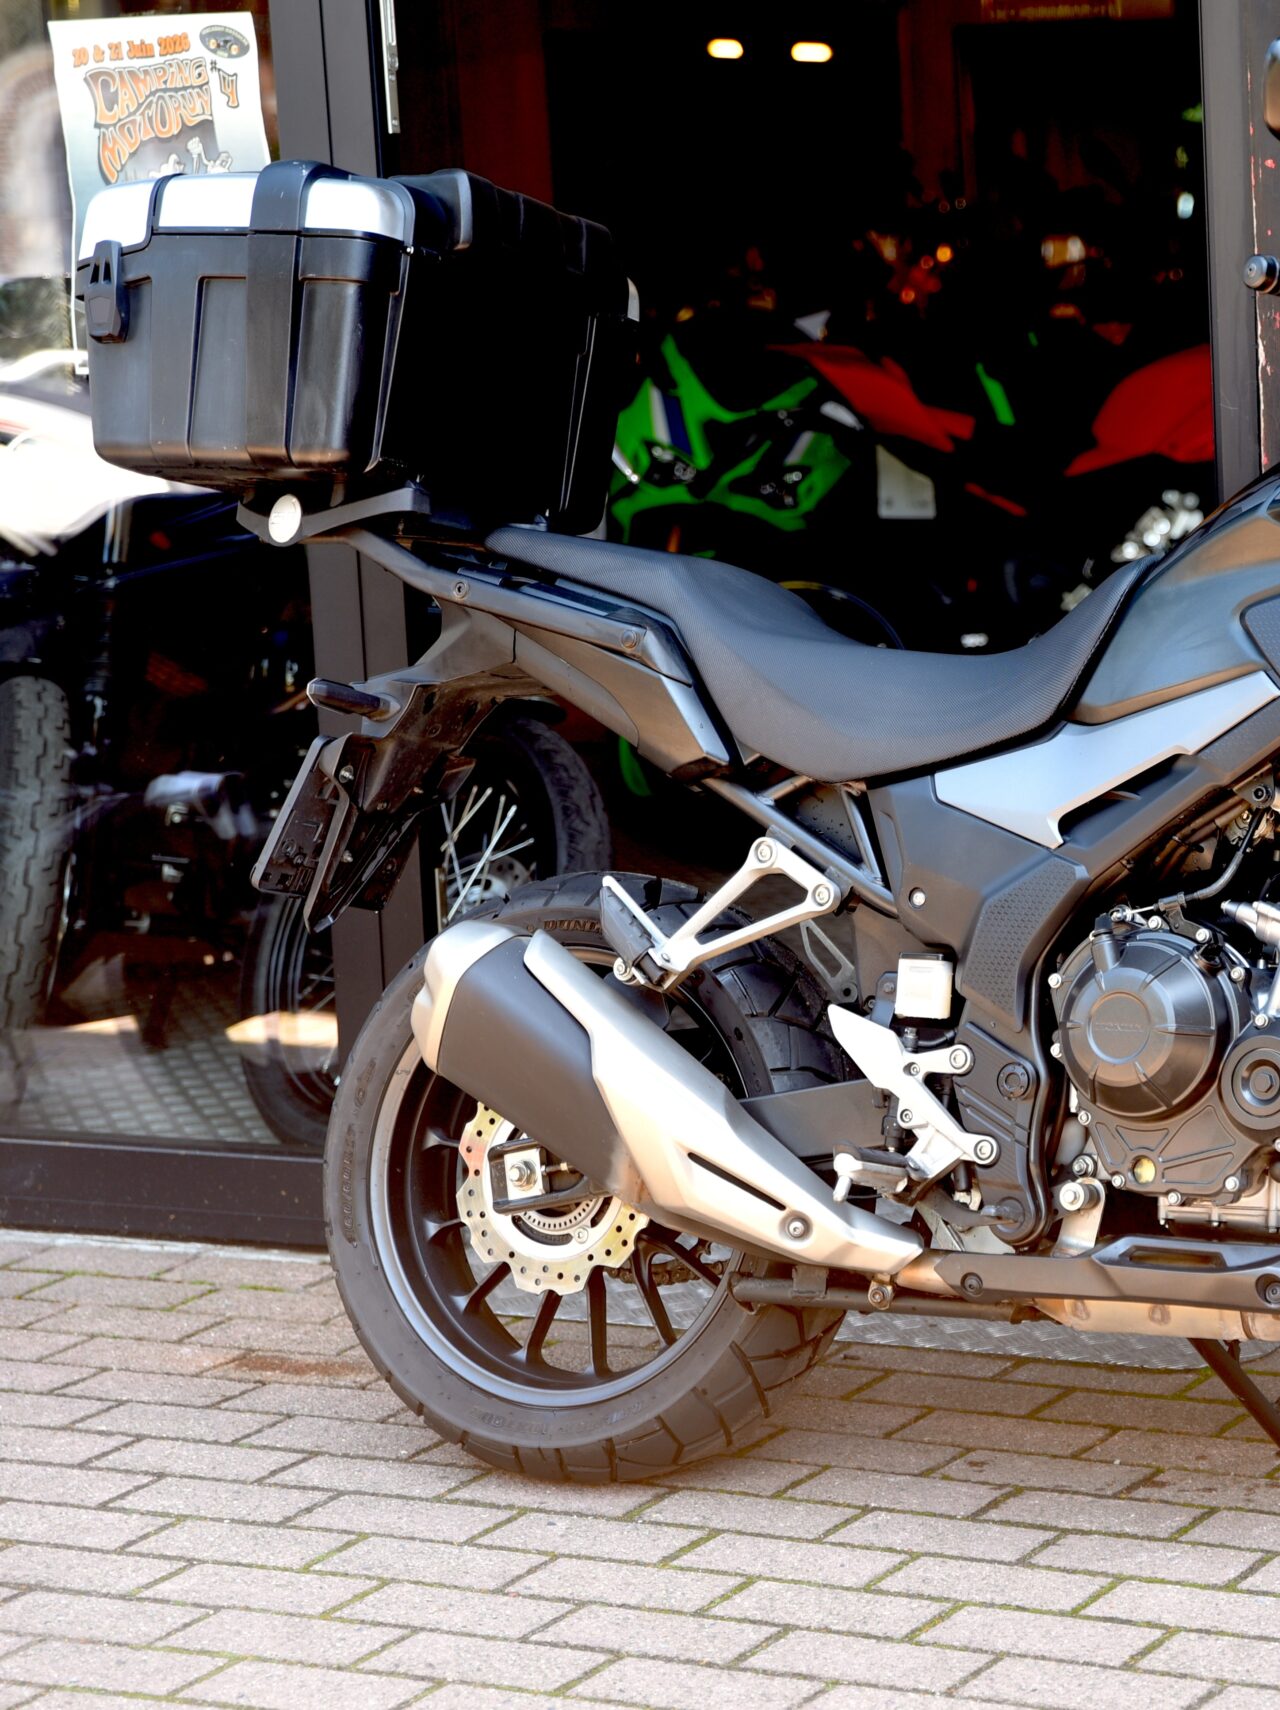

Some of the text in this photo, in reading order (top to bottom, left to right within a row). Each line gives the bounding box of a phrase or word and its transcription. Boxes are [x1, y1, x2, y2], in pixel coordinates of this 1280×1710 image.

[72, 47, 89, 67] 20
[93, 44, 104, 62] &
[108, 41, 124, 61] 21
[127, 38, 155, 59] Juin
[97, 84, 213, 185] MOTORUN
